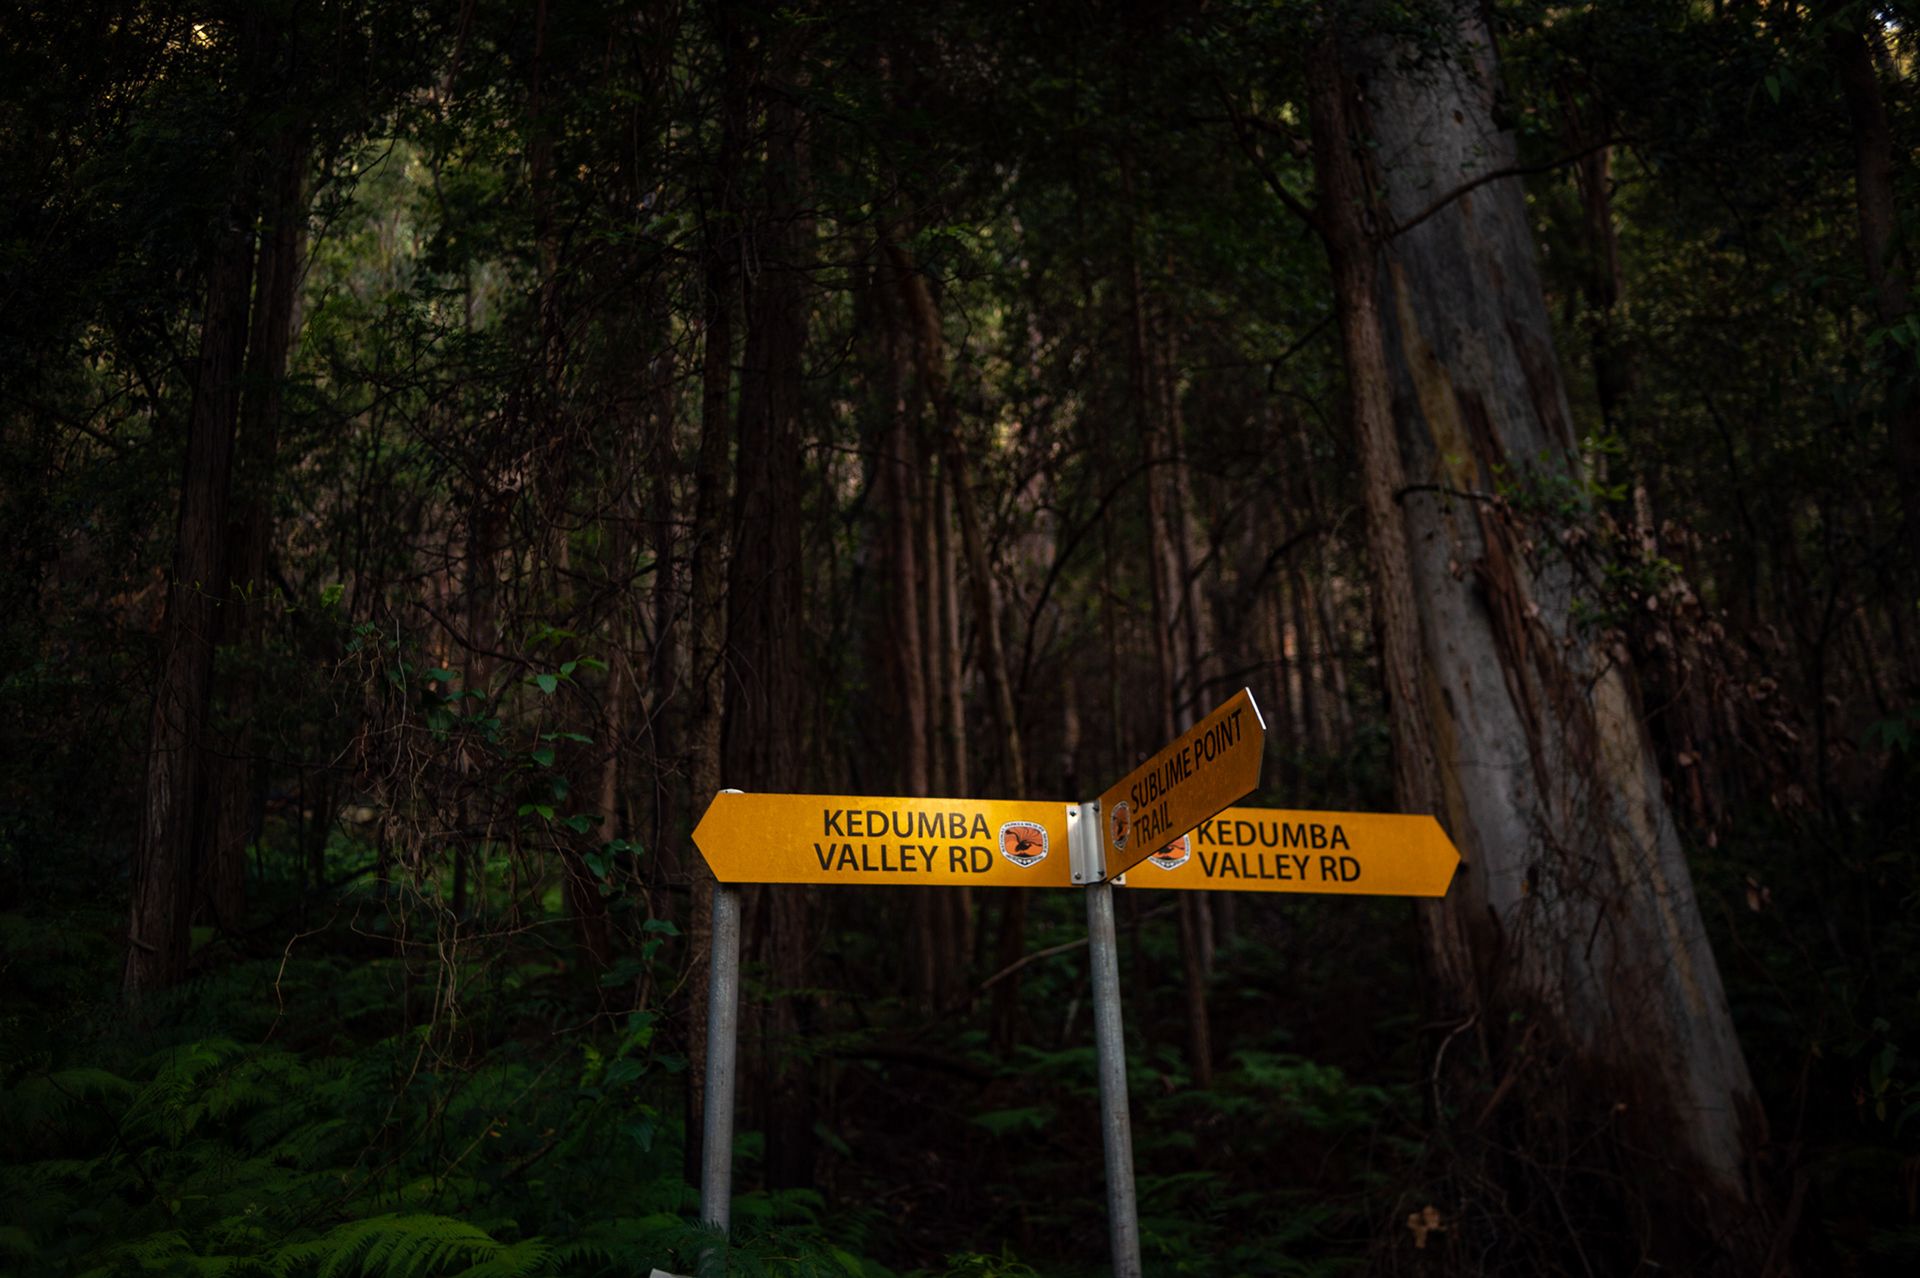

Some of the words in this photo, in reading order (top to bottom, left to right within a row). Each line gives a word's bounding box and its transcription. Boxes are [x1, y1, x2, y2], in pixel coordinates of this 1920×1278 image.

[1131, 747, 1192, 814] SUBLIME
[1194, 708, 1242, 770] POINT
[824, 809, 992, 840] KEDUMBA
[1133, 802, 1173, 848] TRAIL
[1197, 820, 1350, 850] KEDUMBA
[814, 843, 939, 872] VALLEY
[949, 846, 993, 873] RD
[1198, 852, 1310, 881] VALLEY
[1320, 856, 1361, 882] RD
